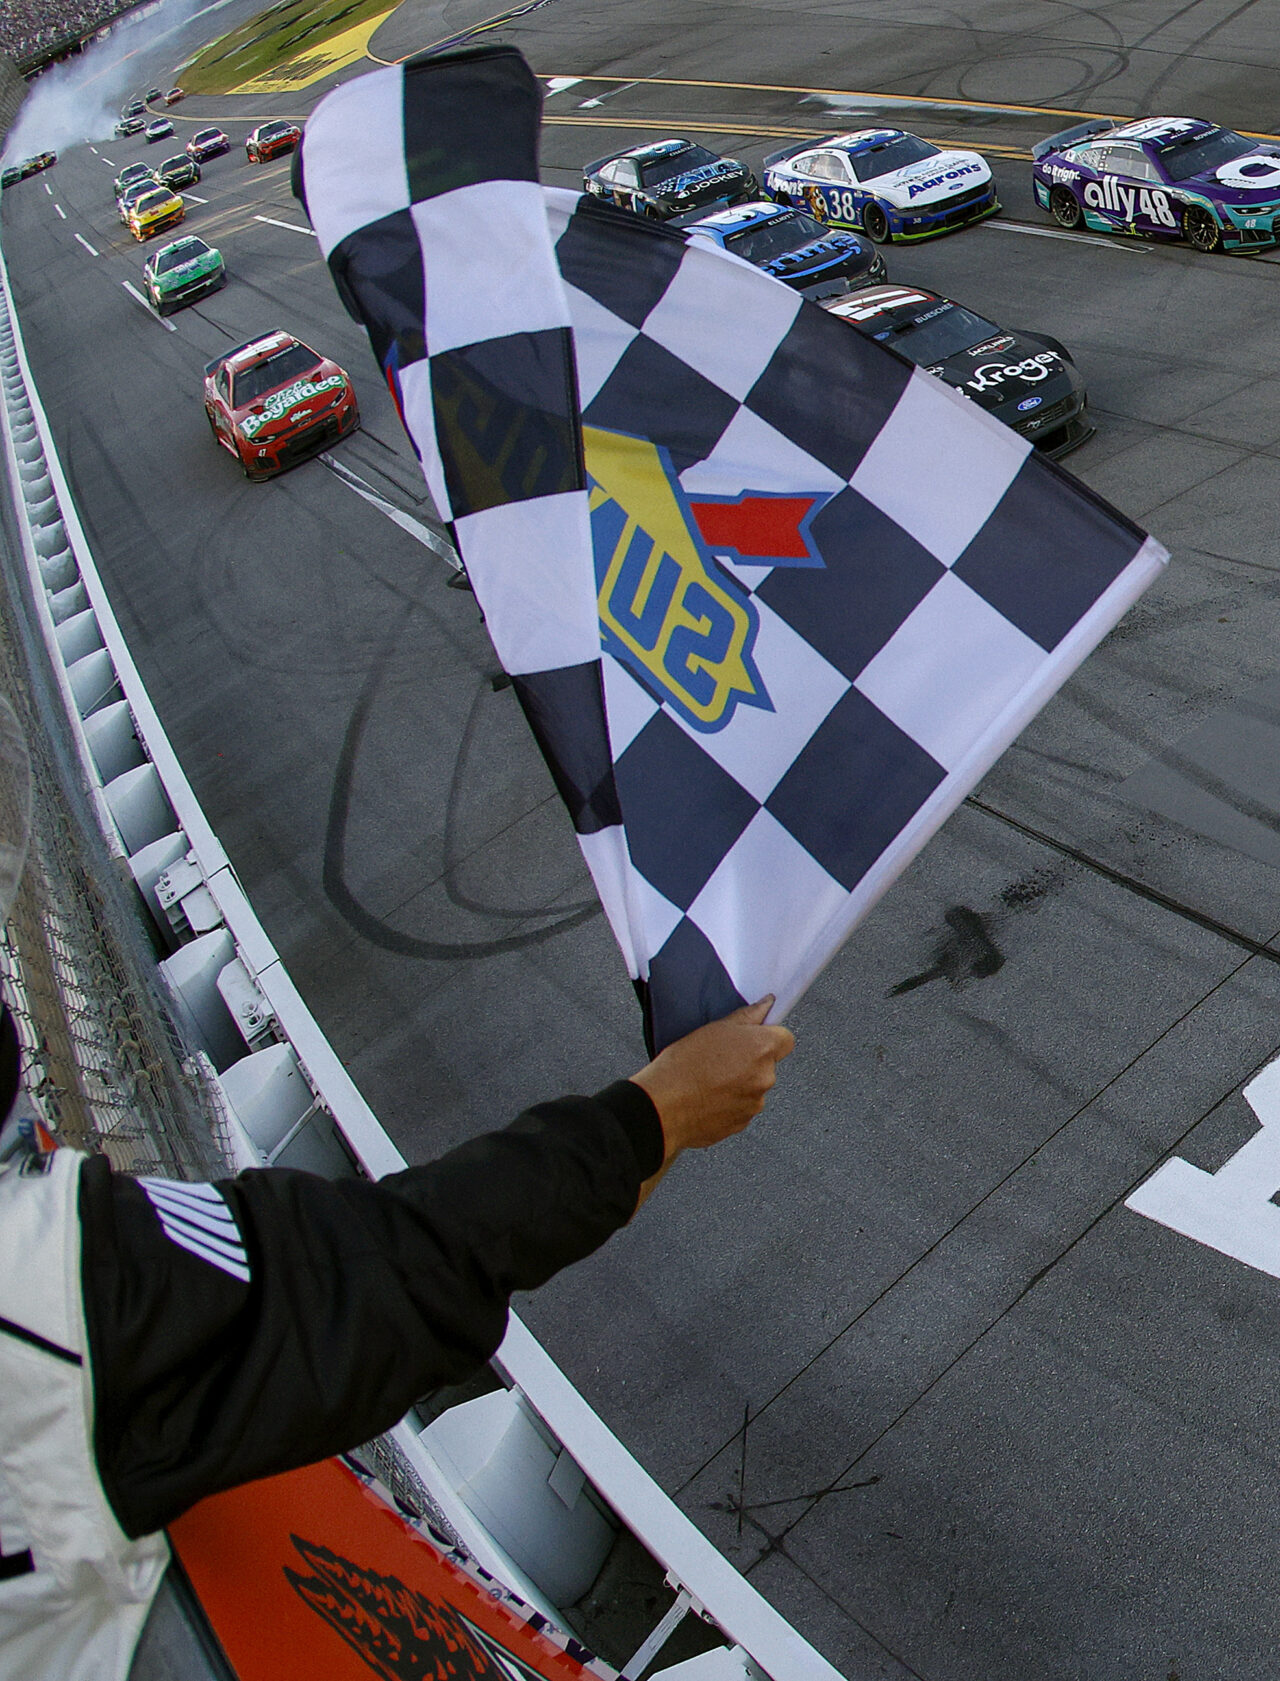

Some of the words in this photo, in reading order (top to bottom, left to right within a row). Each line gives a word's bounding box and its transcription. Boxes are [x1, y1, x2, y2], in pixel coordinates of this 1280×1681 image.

[691, 170, 744, 193] JOCKEY
[908, 163, 981, 200] Aaron's
[829, 189, 855, 221] 38
[1084, 175, 1135, 223] ally
[1140, 189, 1176, 228] 48
[767, 212, 795, 227] ELLIOTT
[1244, 218, 1257, 229] 48
[967, 351, 1063, 392] Kroger
[240, 374, 343, 434] Boyardee
[258, 448, 267, 458] 47
